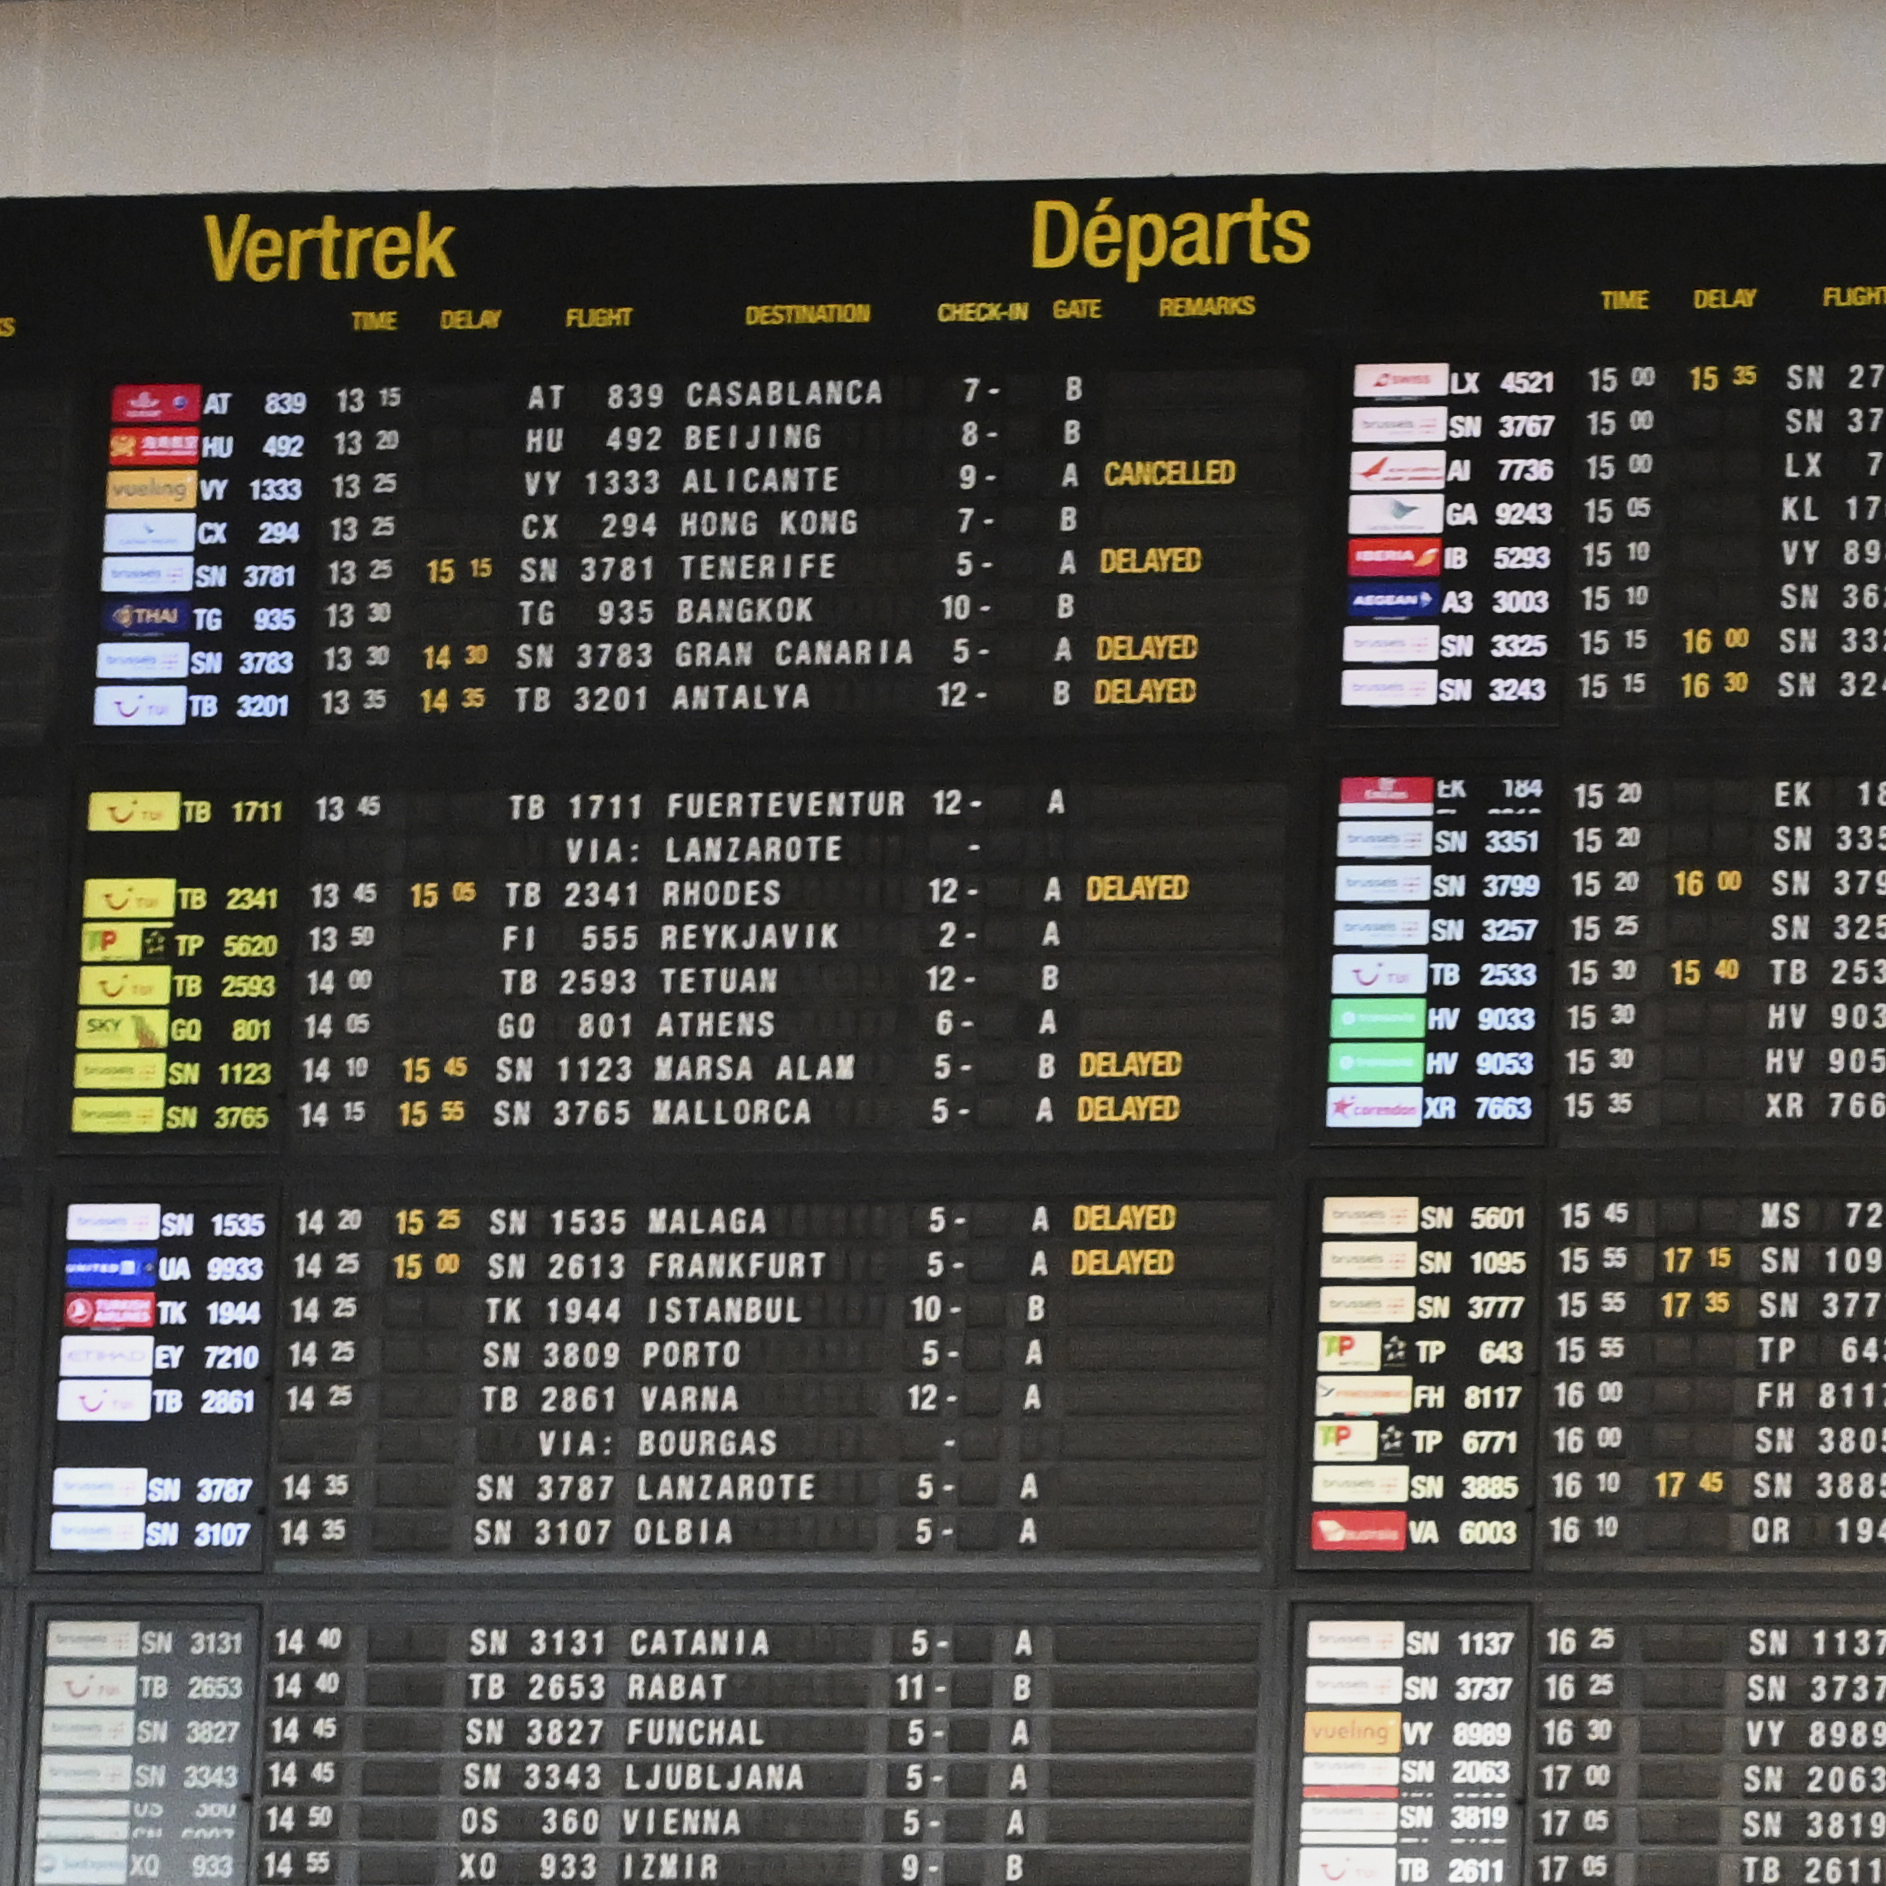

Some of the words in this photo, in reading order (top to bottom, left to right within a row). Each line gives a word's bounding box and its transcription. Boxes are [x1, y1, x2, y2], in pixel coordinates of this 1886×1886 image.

[205, 211, 455, 282] Vertrek
[1032, 197, 1311, 283] Départs
[1601, 290, 1649, 309] TIME
[1694, 289, 1757, 309] DELAY
[352, 311, 397, 330] TIME
[441, 310, 502, 329] DELAY
[566, 307, 633, 328] FLIGHT
[746, 304, 870, 325] DESTINATION
[938, 303, 1029, 322] CHECK-IN
[1053, 299, 1101, 319] GATE
[1160, 296, 1255, 317] REMARKS
[687, 380, 882, 407] CASABLANCA
[685, 423, 820, 450] BEIJING
[586, 469, 659, 495] 1333
[683, 467, 838, 493] ALICANTE
[1104, 460, 1236, 486] CANCELLED
[681, 511, 757, 536] HONG
[781, 509, 857, 535] KONG
[581, 556, 652, 582] 3781
[681, 553, 835, 580] TENERIFE
[1101, 547, 1201, 573] DELAYED
[1355, 550, 1414, 563] IBERIA
[677, 597, 812, 623] BANGKOK
[1353, 594, 1418, 607] AEGEAN
[136, 607, 178, 624] THAI
[676, 642, 752, 667] GRAN
[776, 639, 912, 666] CANARIA
[672, 684, 809, 709] ANTALYA
[1095, 678, 1196, 704] DELAYED
[668, 791, 904, 818] FUERTEVENTUR
[666, 836, 841, 862] LANZAROTE
[565, 882, 637, 907] 2341
[663, 880, 780, 906] RHODES
[1087, 875, 1189, 901] DELAYED
[661, 924, 837, 949] REYKJAVIK
[560, 969, 636, 994] 2593
[661, 968, 777, 993] TETUAN
[86, 1016, 123, 1034] SKY
[653, 1099, 810, 1125] MALLORCA
[649, 1208, 766, 1234] MALAGA
[1074, 1204, 1176, 1231] DELAYED
[649, 1252, 825, 1278] FRANKFURT
[649, 1297, 800, 1323] ISTANBUL
[643, 1340, 740, 1367] PORTO
[542, 1386, 614, 1412] 2861
[642, 1386, 738, 1411] VARNA
[639, 1429, 776, 1456] BOURGAS
[538, 1475, 613, 1501] 3787
[638, 1474, 814, 1500] LANZAROTE
[635, 1518, 732, 1545] OLBIA
[529, 1674, 604, 1700] 2653
[628, 1674, 726, 1700] RABAT
[628, 1719, 764, 1745] FUNCHAL
[1312, 1719, 1389, 1745] vueling
[626, 1764, 803, 1790] LJUBLJANA
[1808, 1766, 1886, 1793] 2063
[623, 1808, 740, 1835] VIENNA
[625, 1853, 717, 1880] IZMIR
